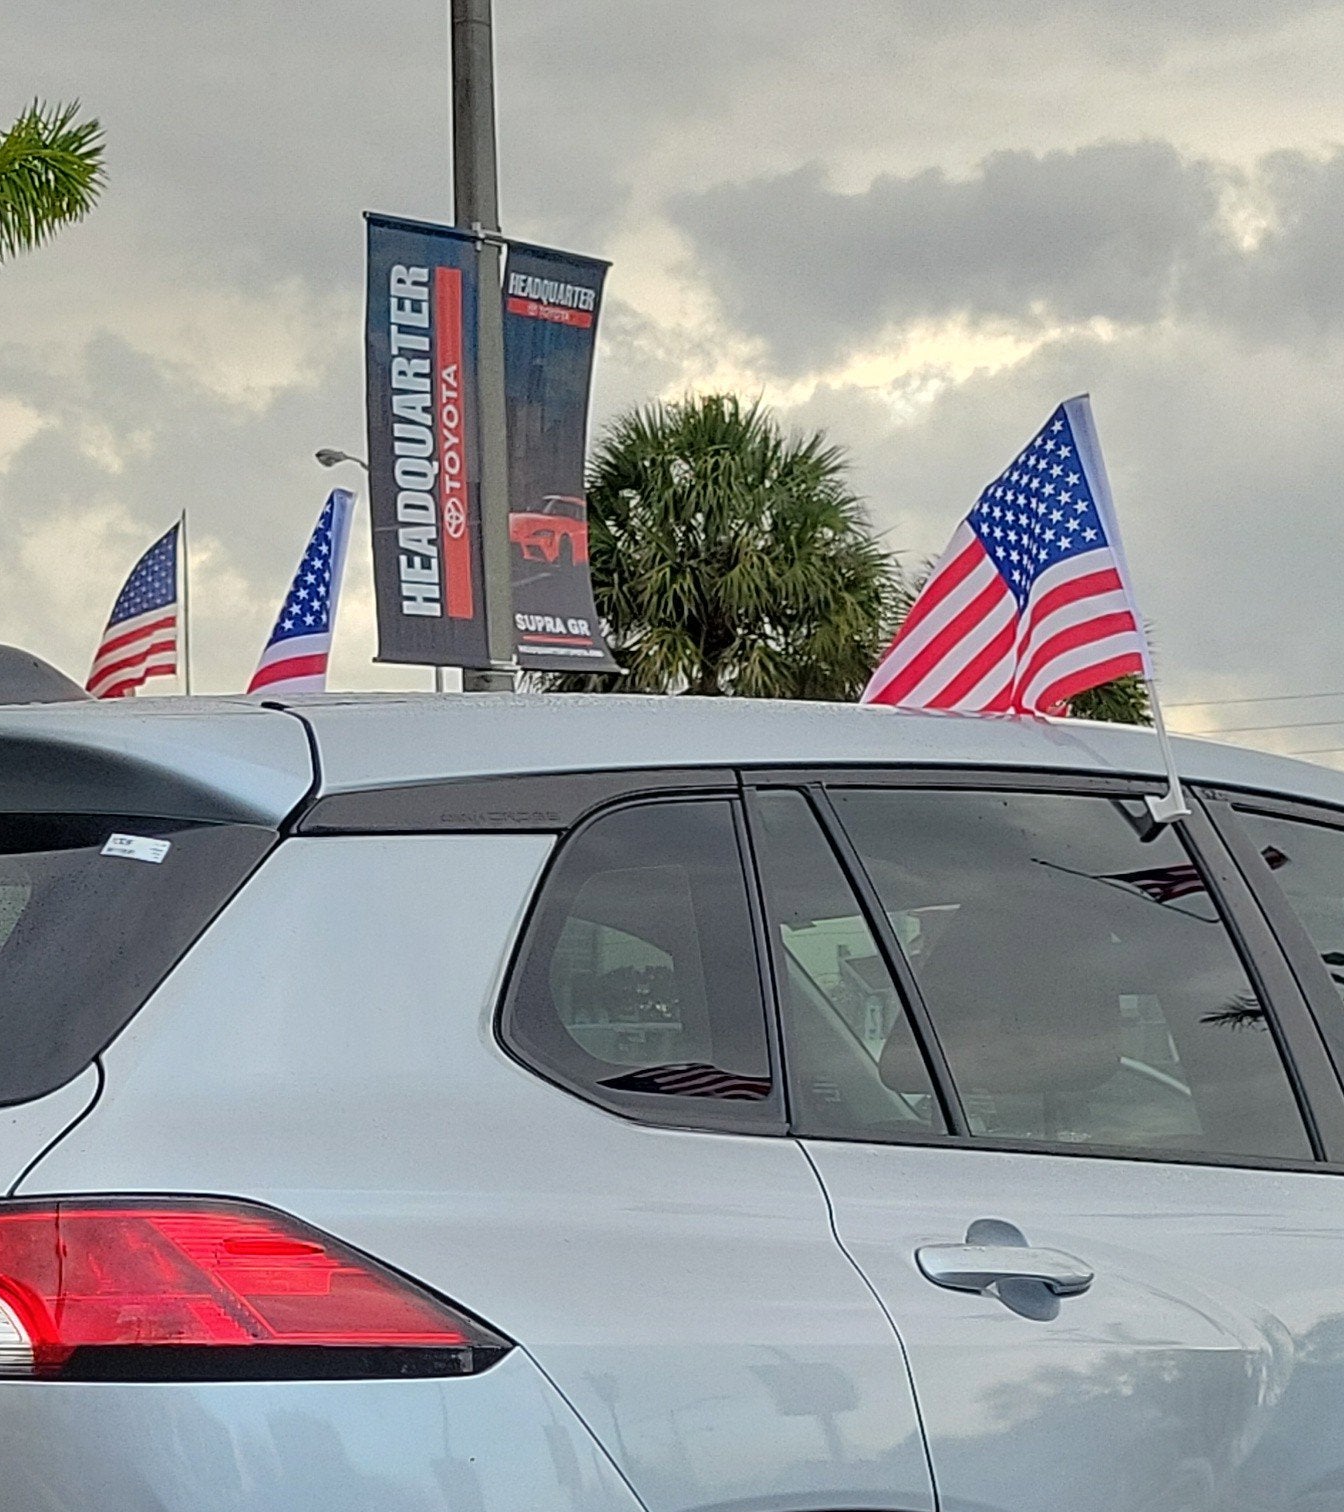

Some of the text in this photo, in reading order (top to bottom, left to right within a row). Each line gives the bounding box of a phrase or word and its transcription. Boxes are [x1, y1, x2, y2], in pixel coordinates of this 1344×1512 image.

[508, 272, 596, 311] HEADQUARTER
[390, 263, 443, 618] HEADQUARTER
[441, 364, 462, 495] TOYOTA
[515, 613, 591, 637] SUPRA GR
